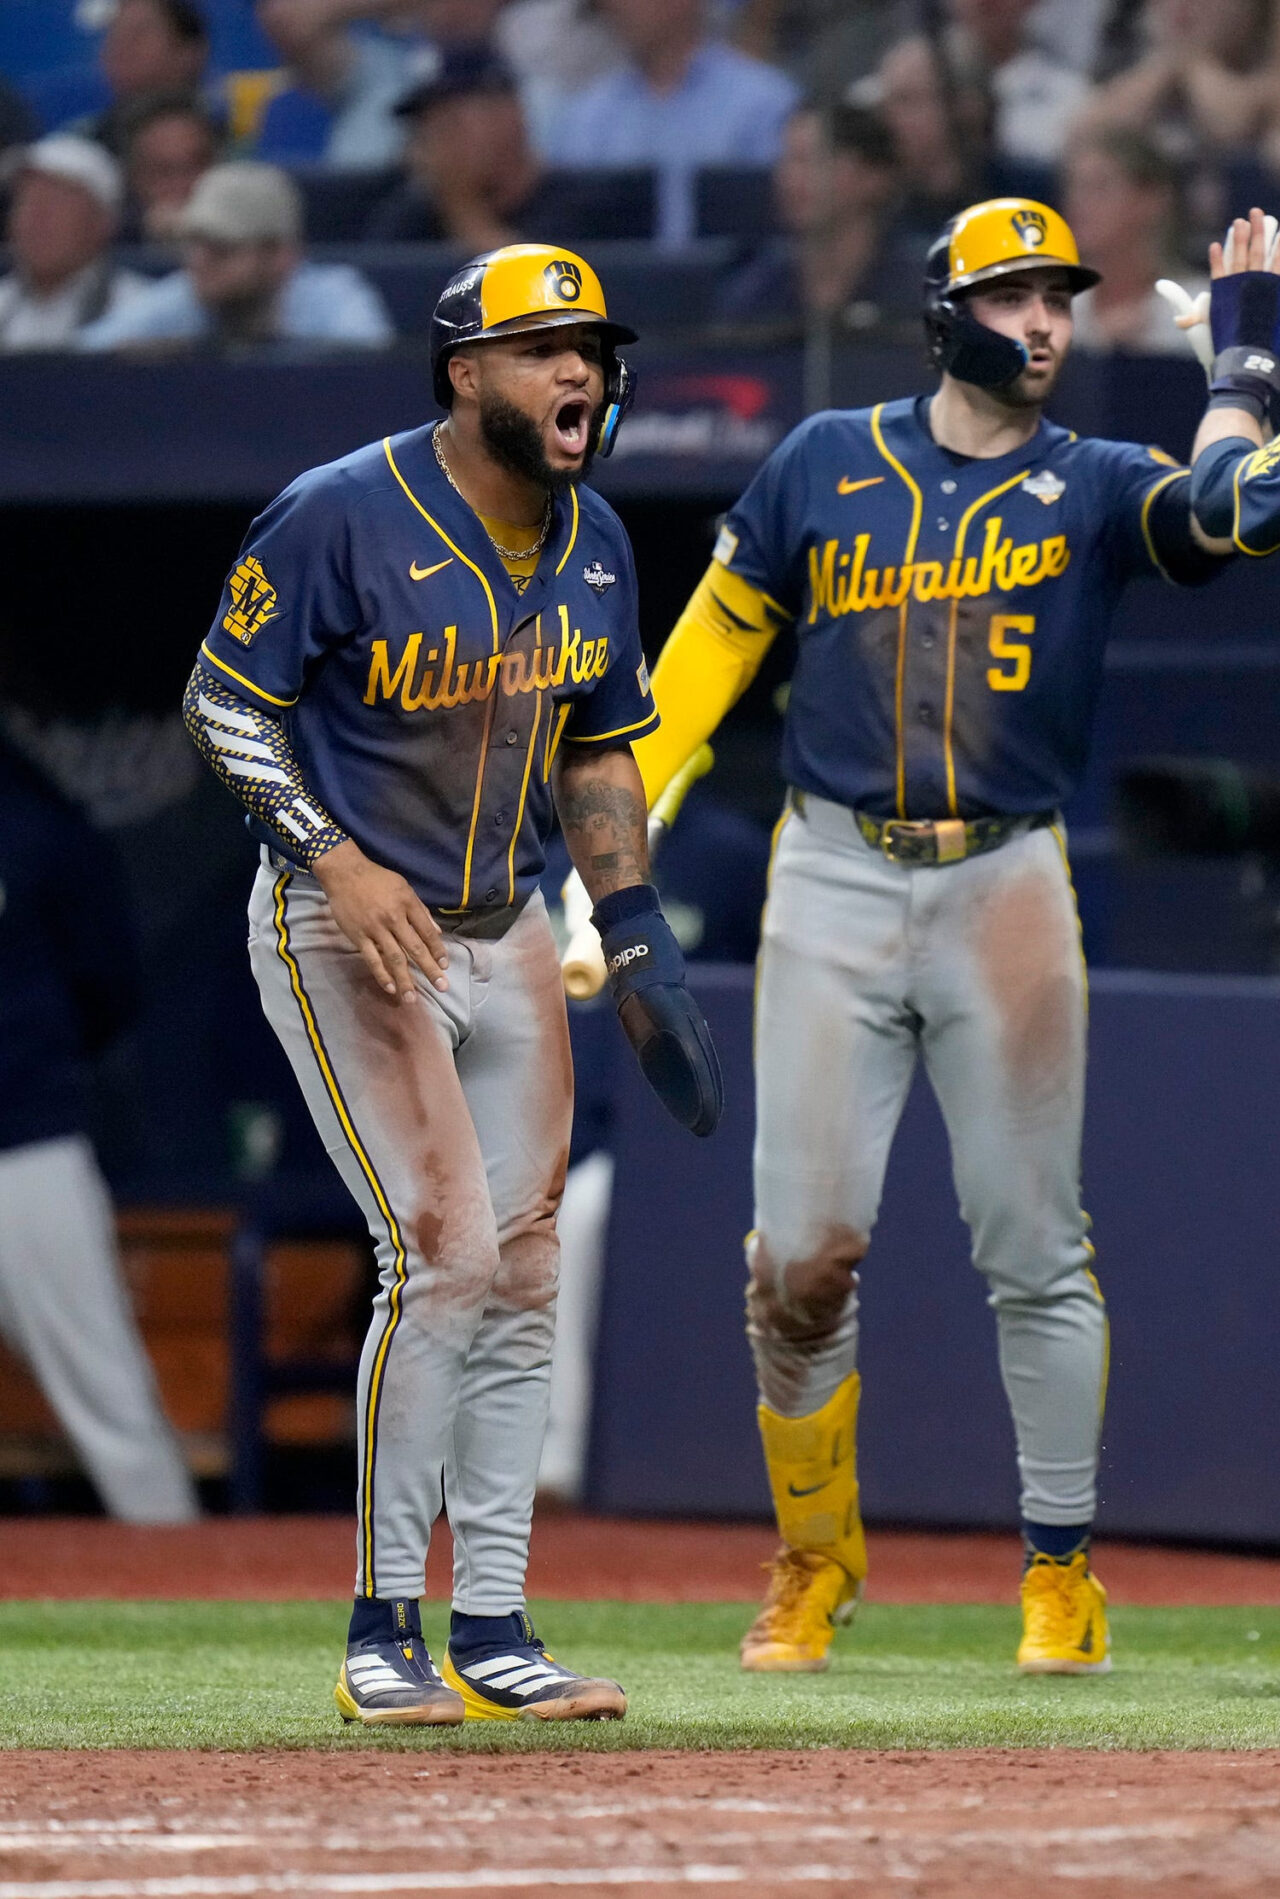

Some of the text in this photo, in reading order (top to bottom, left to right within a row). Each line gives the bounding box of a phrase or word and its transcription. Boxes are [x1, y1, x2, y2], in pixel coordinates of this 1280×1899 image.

[1244, 355, 1275, 373] 22
[807, 516, 1071, 625] Milwaukee
[363, 604, 610, 712] Milwaukee
[986, 614, 1036, 692] 5
[608, 944, 649, 974] adida
[396, 1602, 406, 1629] DIZERO
